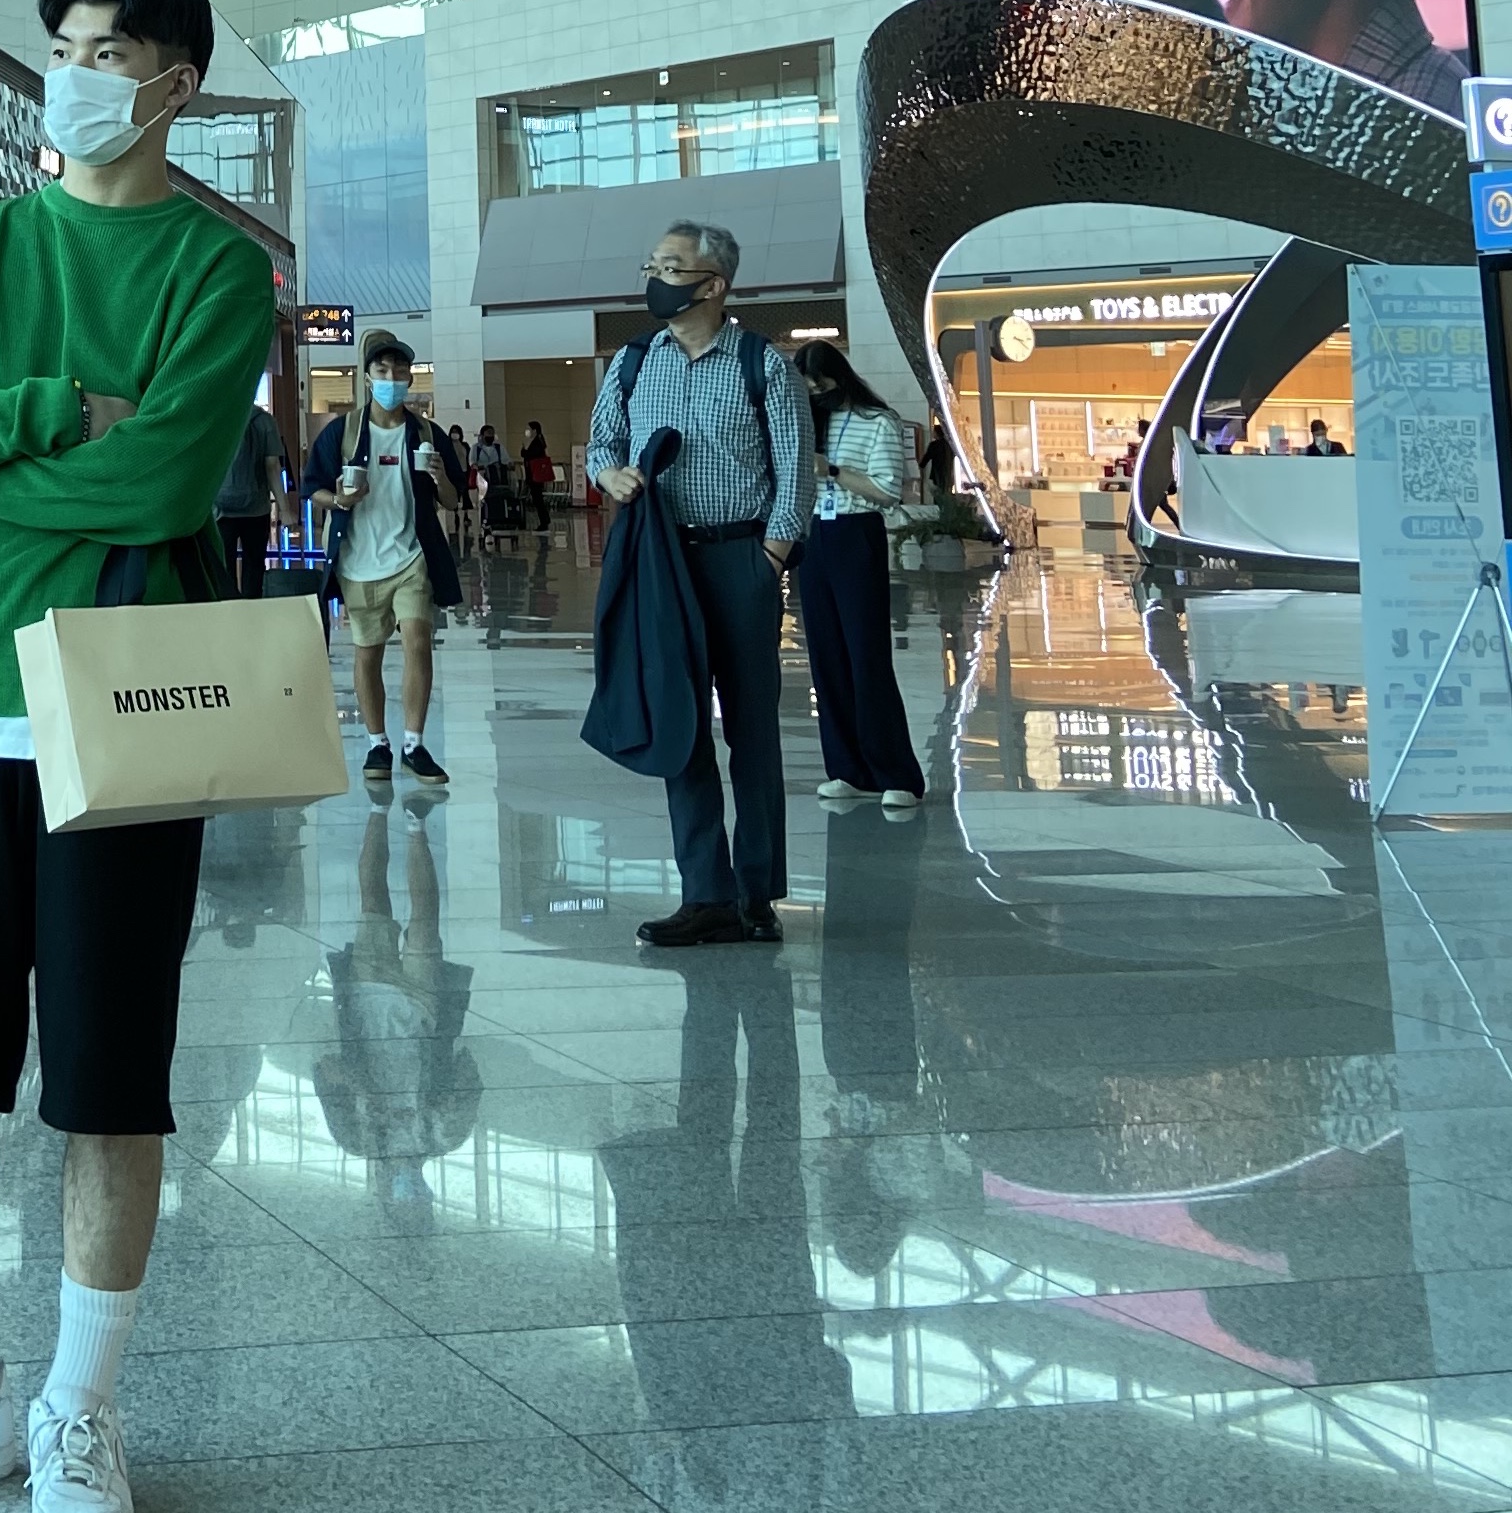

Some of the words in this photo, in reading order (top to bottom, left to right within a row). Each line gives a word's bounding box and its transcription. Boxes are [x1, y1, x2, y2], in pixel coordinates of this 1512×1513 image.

[522, 116, 552, 131] TRANSIT
[554, 119, 577, 133] HOTEL
[1090, 296, 1141, 321] TOYS
[1143, 296, 1160, 319] &
[113, 685, 231, 714] MONSTER
